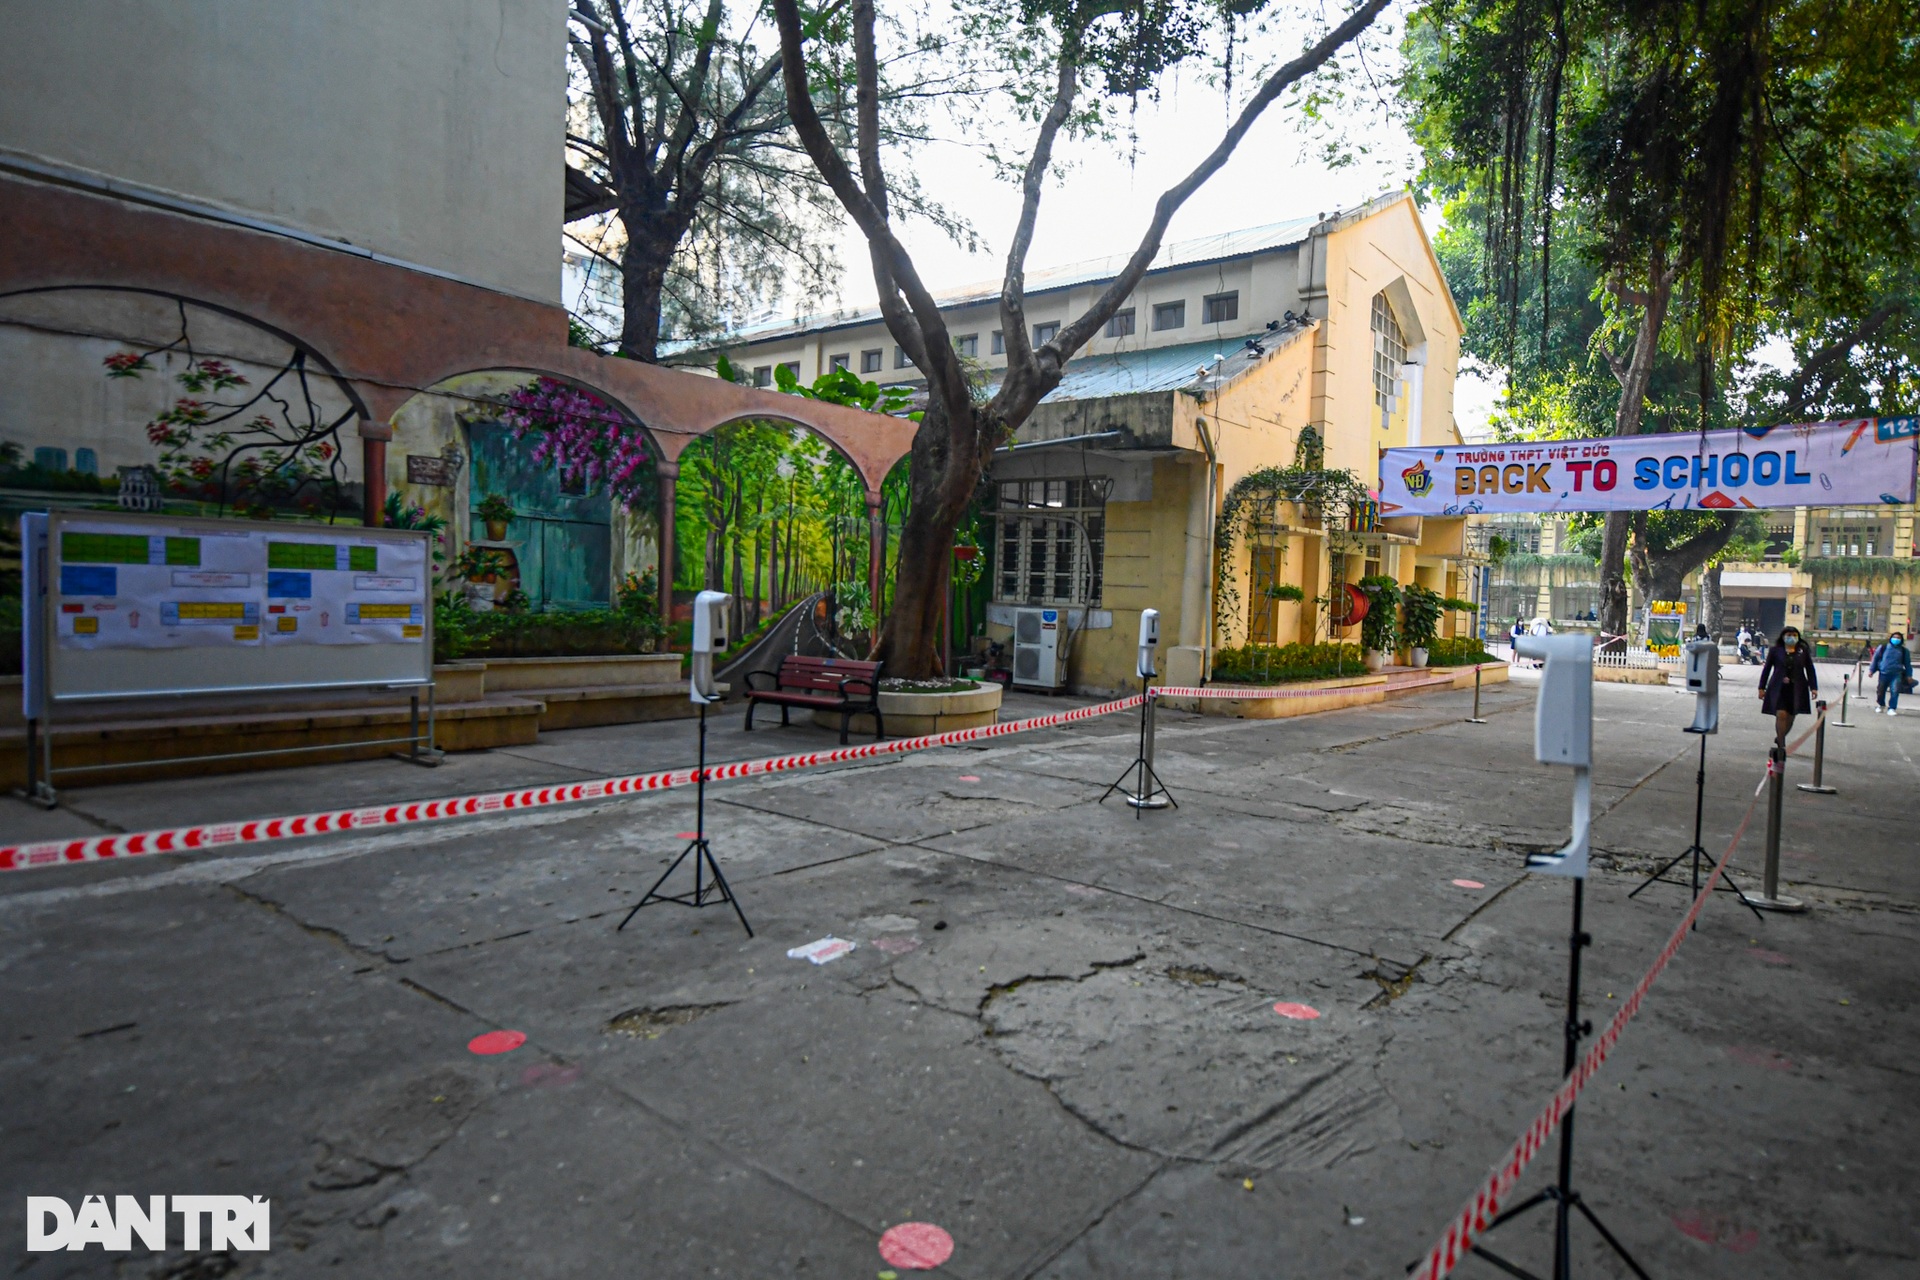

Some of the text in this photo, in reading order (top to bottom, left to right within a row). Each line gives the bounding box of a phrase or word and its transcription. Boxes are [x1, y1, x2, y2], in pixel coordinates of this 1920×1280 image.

[1510, 449, 1544, 461] THPT
[1548, 445, 1578, 460] VIỆT
[1582, 443, 1610, 457] ĐỨC
[1455, 450, 1811, 495] BACK TO SCHOOL
[1791, 604, 1800, 614] B
